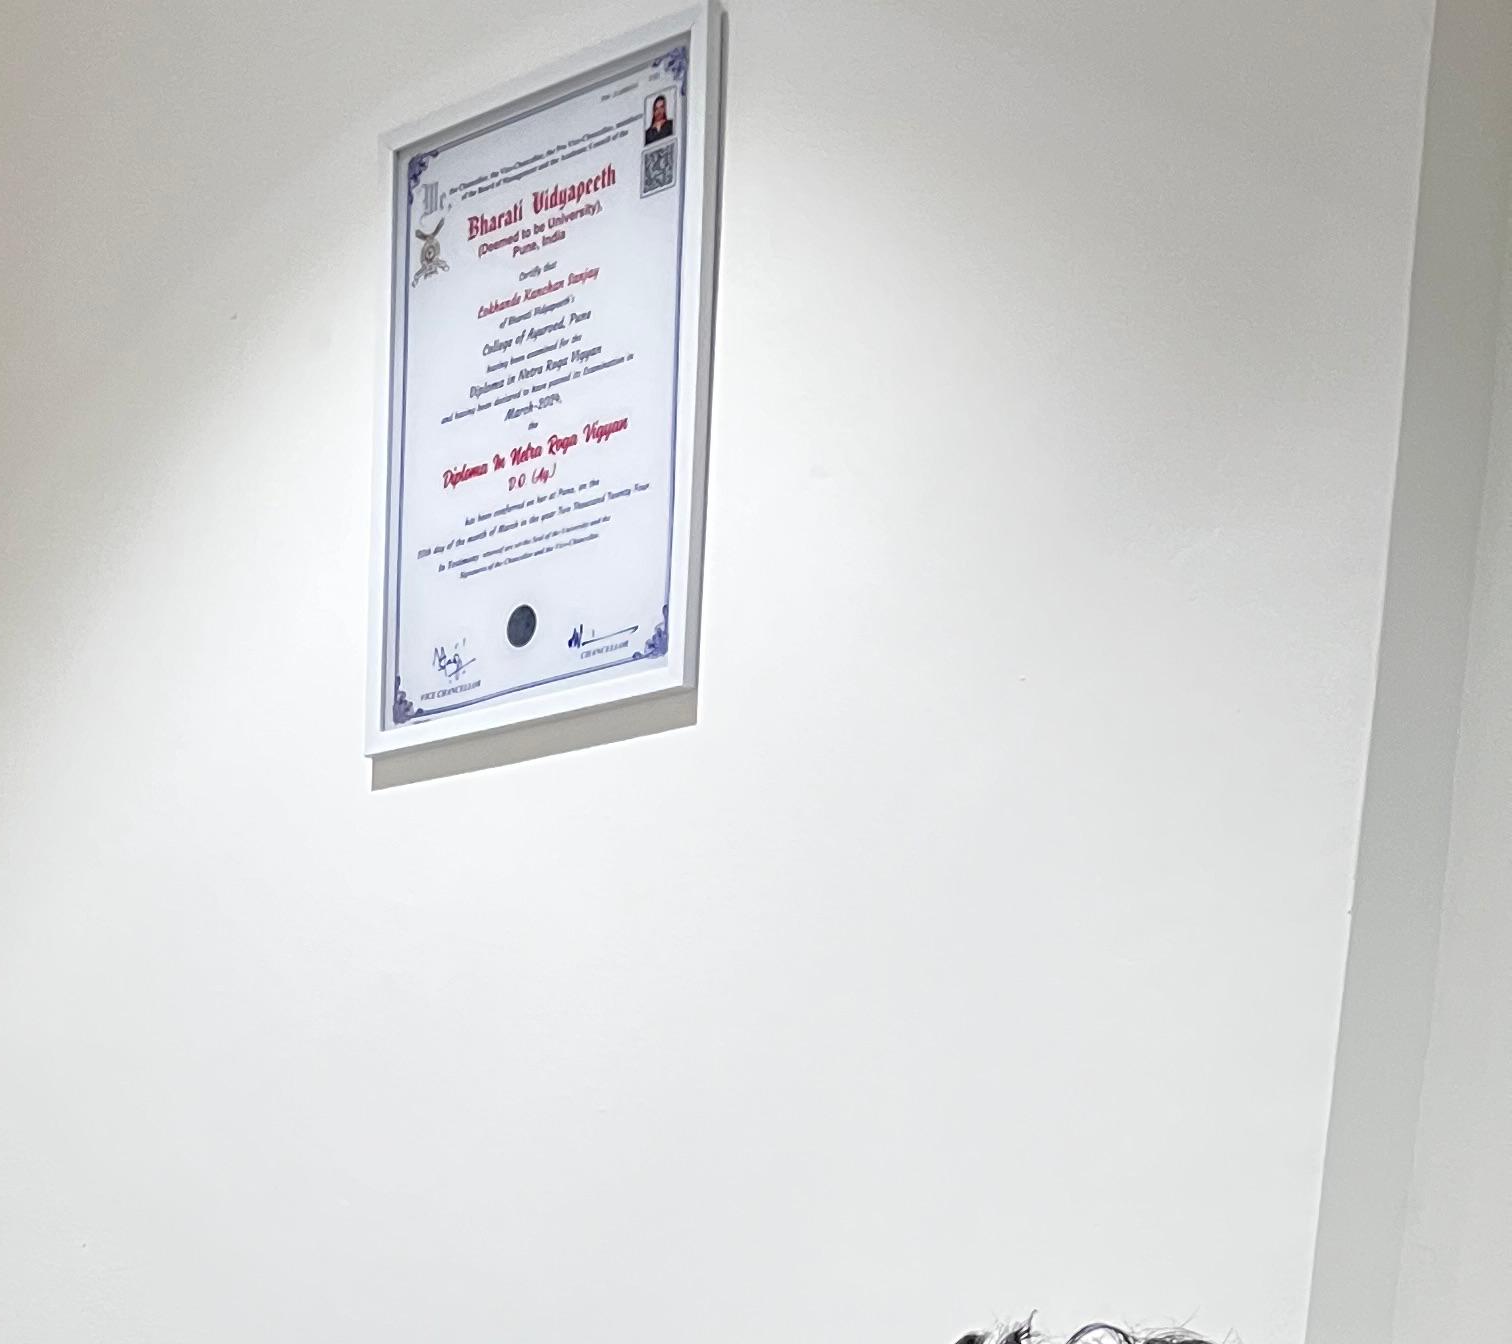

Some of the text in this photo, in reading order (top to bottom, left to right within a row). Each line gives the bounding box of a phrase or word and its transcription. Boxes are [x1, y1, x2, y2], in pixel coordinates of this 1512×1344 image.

[467, 163, 616, 241] Bharati Vidyapeeth
[478, 230, 520, 258] (Deemed
[521, 228, 531, 240] to
[533, 223, 546, 235] be
[541, 230, 566, 247] India
[519, 265, 542, 282] Certify
[482, 338, 513, 356] College
[515, 329, 527, 345] of
[469, 379, 505, 399] Diploma
[518, 365, 543, 381] Netra
[443, 463, 488, 489] Diploma
[510, 442, 542, 466] Netra
[547, 434, 578, 455] Roga
